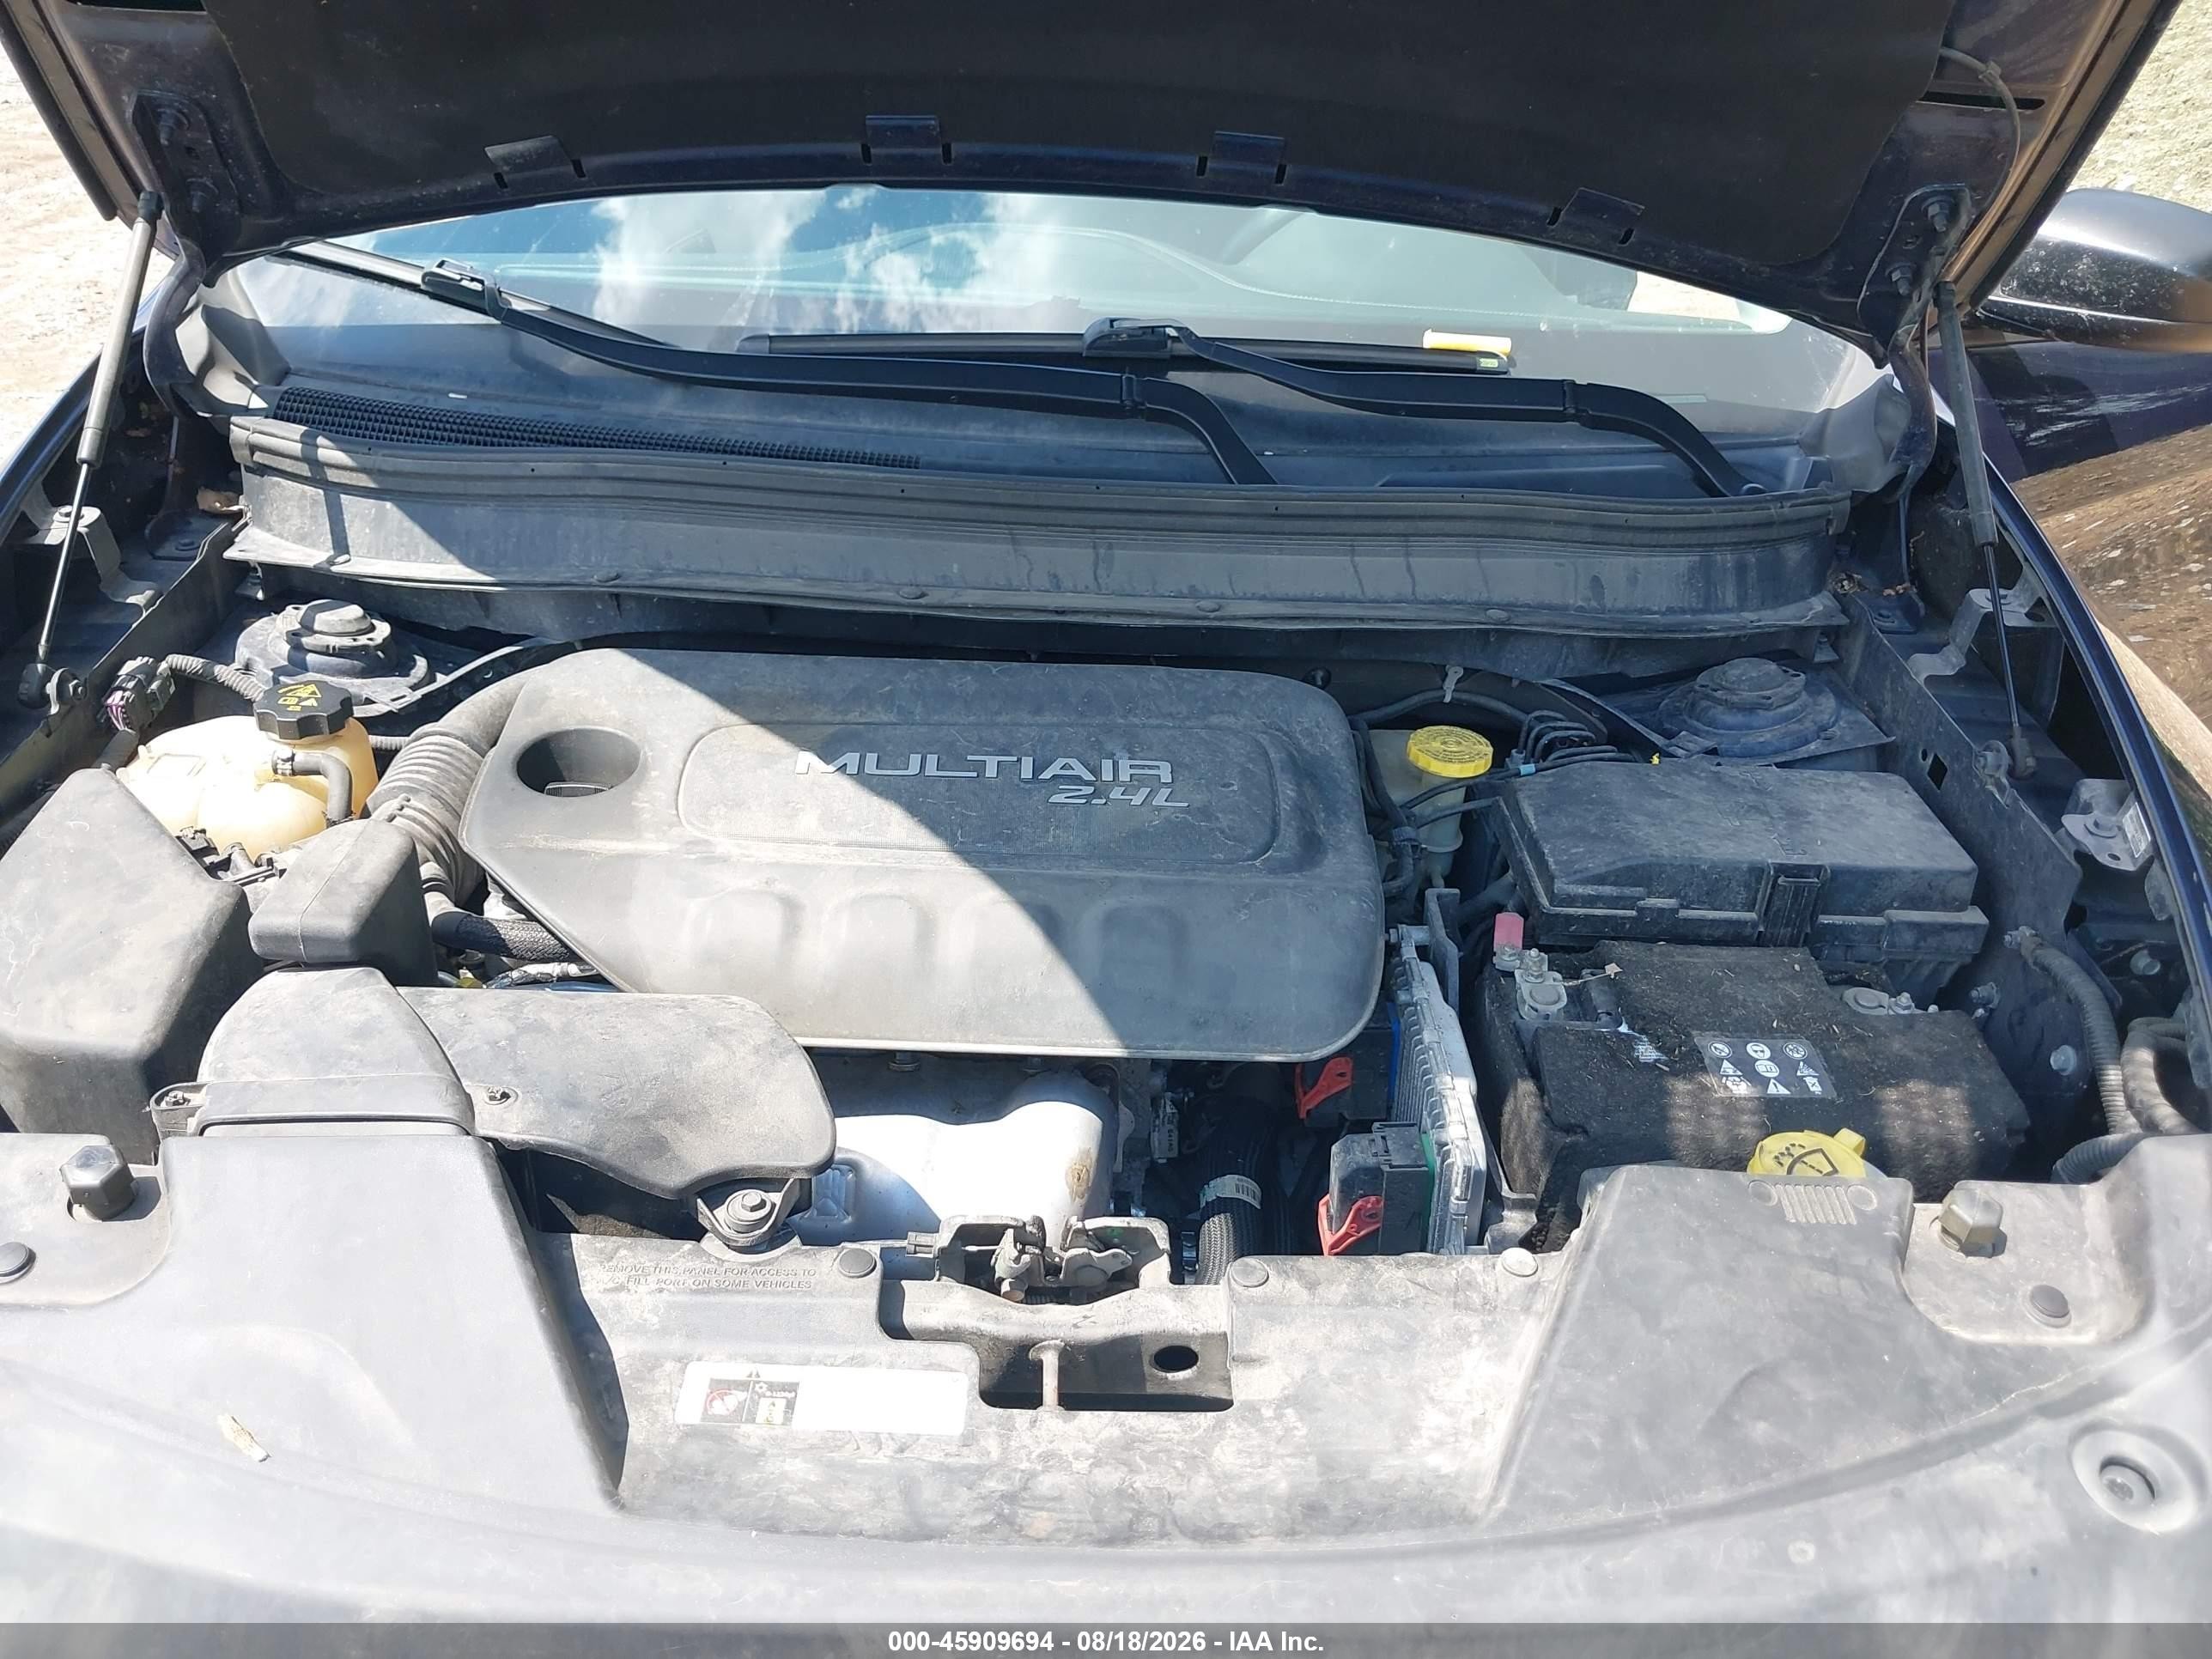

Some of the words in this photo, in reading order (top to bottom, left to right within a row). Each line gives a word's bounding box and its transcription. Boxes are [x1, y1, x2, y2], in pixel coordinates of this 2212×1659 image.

[793, 750, 1173, 783] MULTIAIR
[1047, 784, 1191, 808] 2.4L
[600, 1263, 650, 1274] REMOVE
[683, 1266, 720, 1276] PANEL
[724, 1267, 750, 1276] FOR
[750, 1267, 798, 1277] ACCESS
[802, 1267, 817, 1278] TO
[626, 1275, 650, 1285] FILL
[692, 1278, 711, 1288] ON
[714, 1279, 750, 1289] SOME
[754, 1279, 811, 1290] VEHICLES
